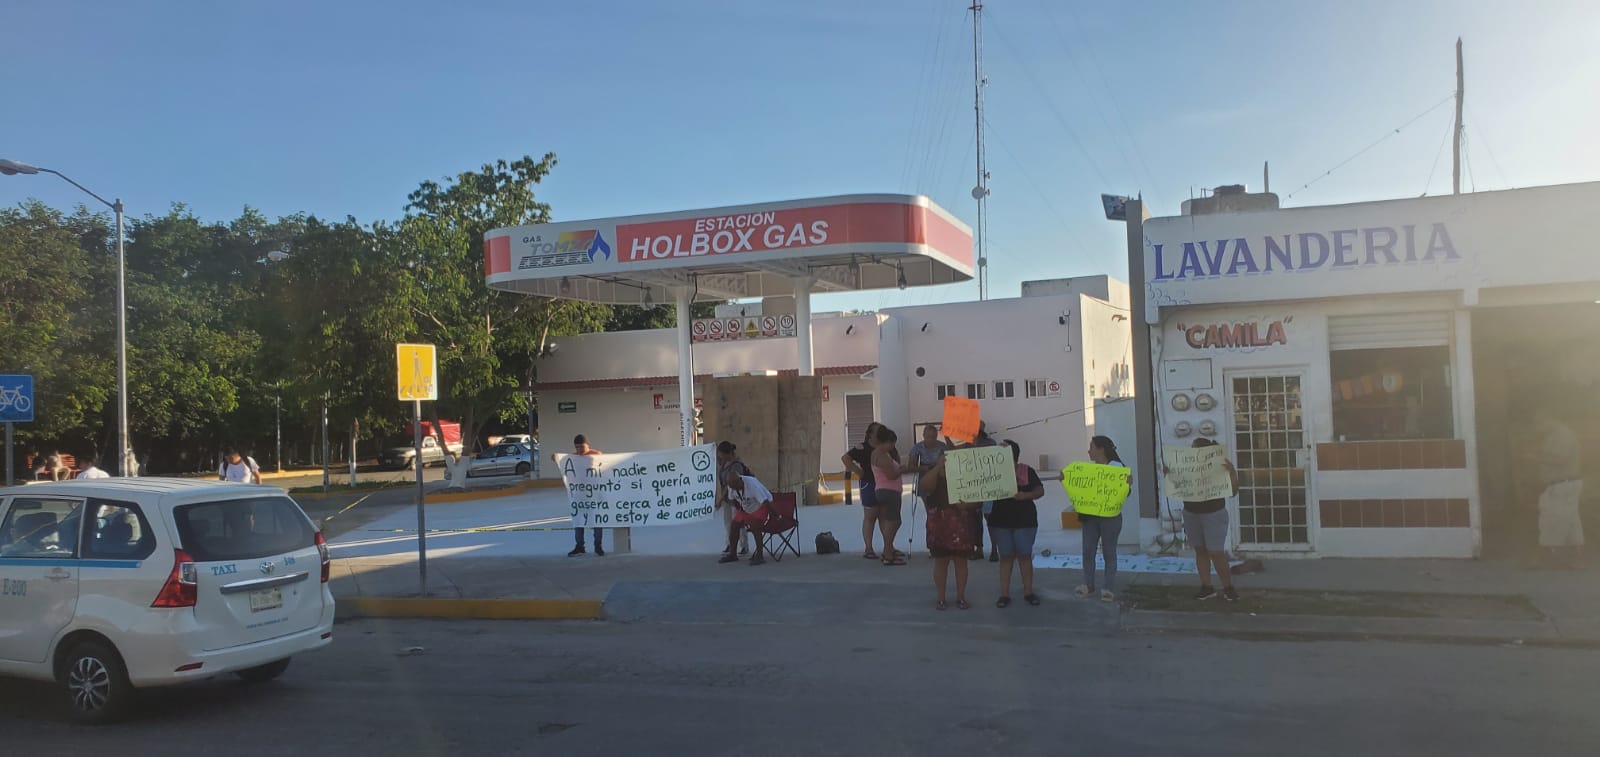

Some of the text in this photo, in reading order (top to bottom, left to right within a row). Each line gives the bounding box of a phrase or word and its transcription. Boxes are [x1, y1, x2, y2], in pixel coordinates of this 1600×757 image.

[522, 235, 542, 244] GAS
[630, 220, 829, 260] HOLBOX GAS
[1152, 221, 1462, 281] LAVANDERIA
[564, 457, 576, 477] A
[613, 462, 648, 478] nadie
[656, 461, 676, 473] me
[954, 449, 1005, 476] Peligro
[569, 473, 714, 498] preguntó si quería una
[571, 490, 714, 517] gasera cerca de mi casa
[583, 504, 713, 526] y no estoy de acuerdo
[211, 564, 237, 576] TAXI
